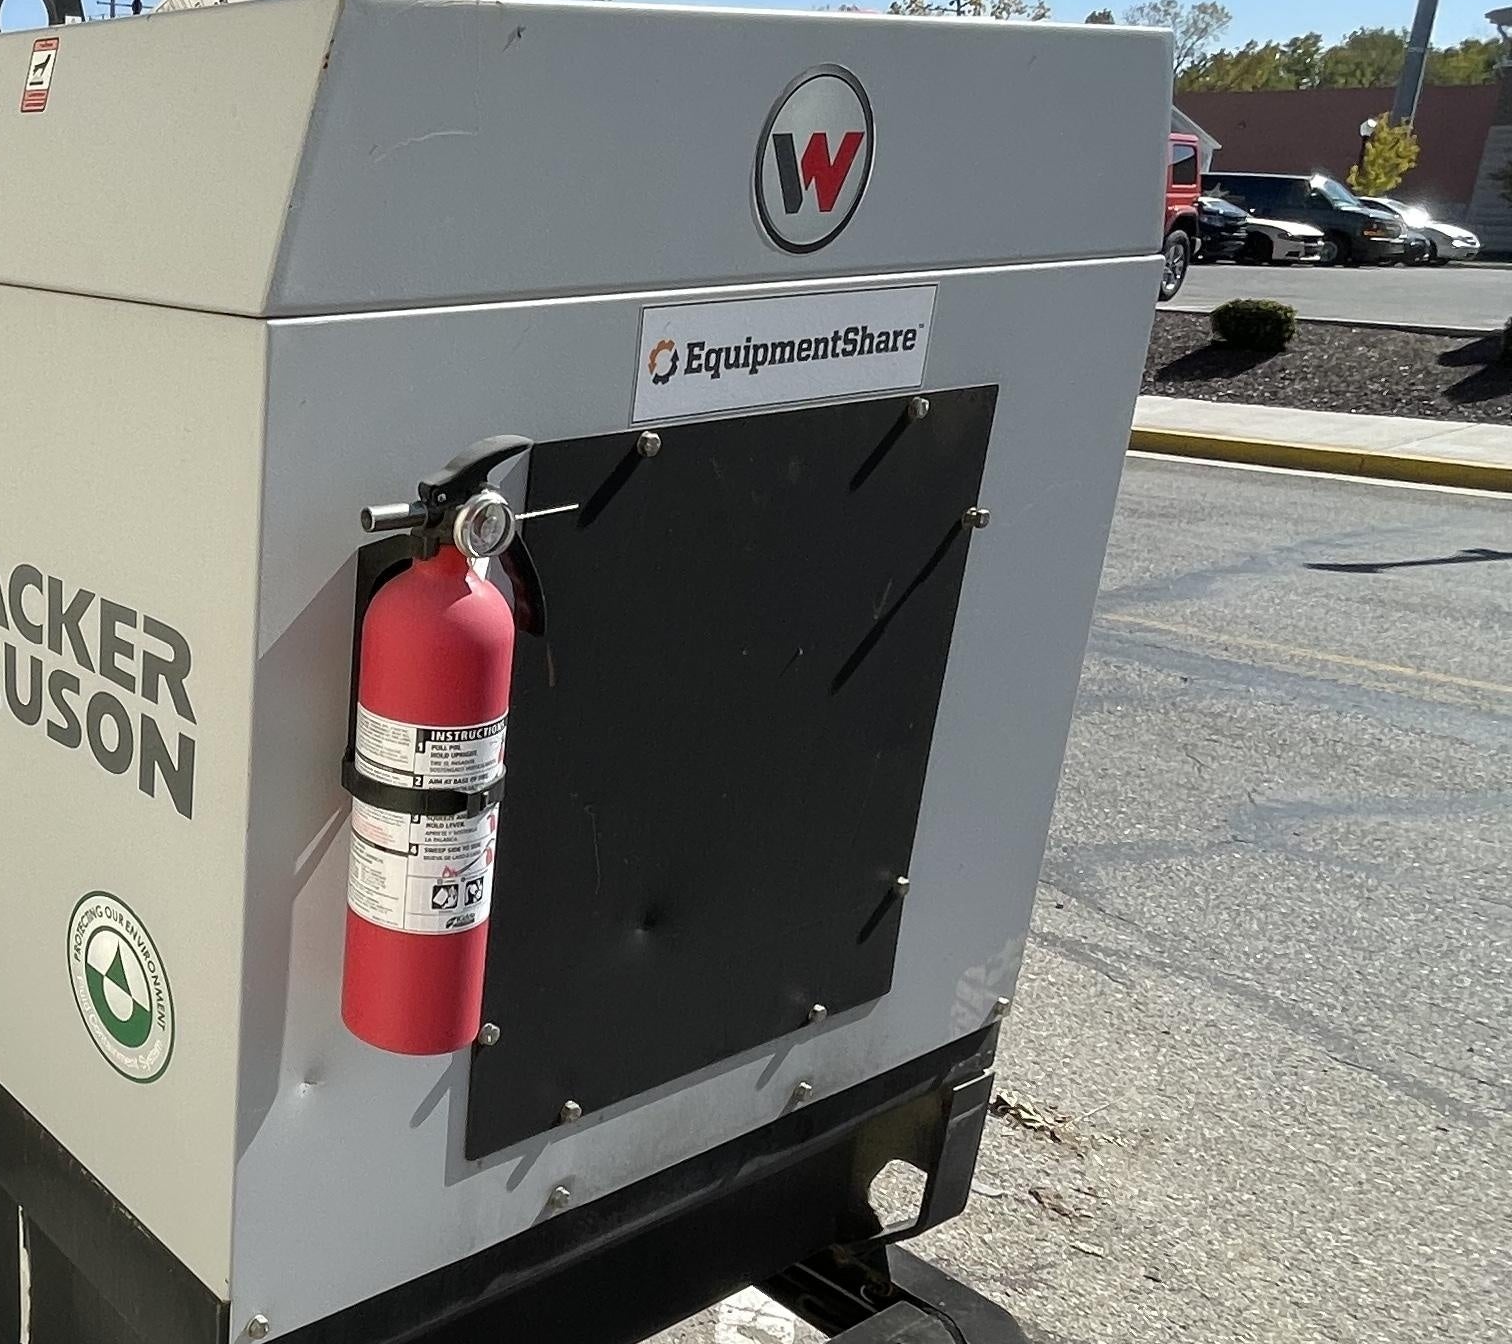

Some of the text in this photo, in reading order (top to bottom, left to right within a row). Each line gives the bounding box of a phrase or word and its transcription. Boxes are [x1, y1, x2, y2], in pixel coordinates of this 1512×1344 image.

[684, 325, 918, 379] EquipmentShare
[73, 904, 167, 1032] PROTECTING OUR ENVIRONMENT
